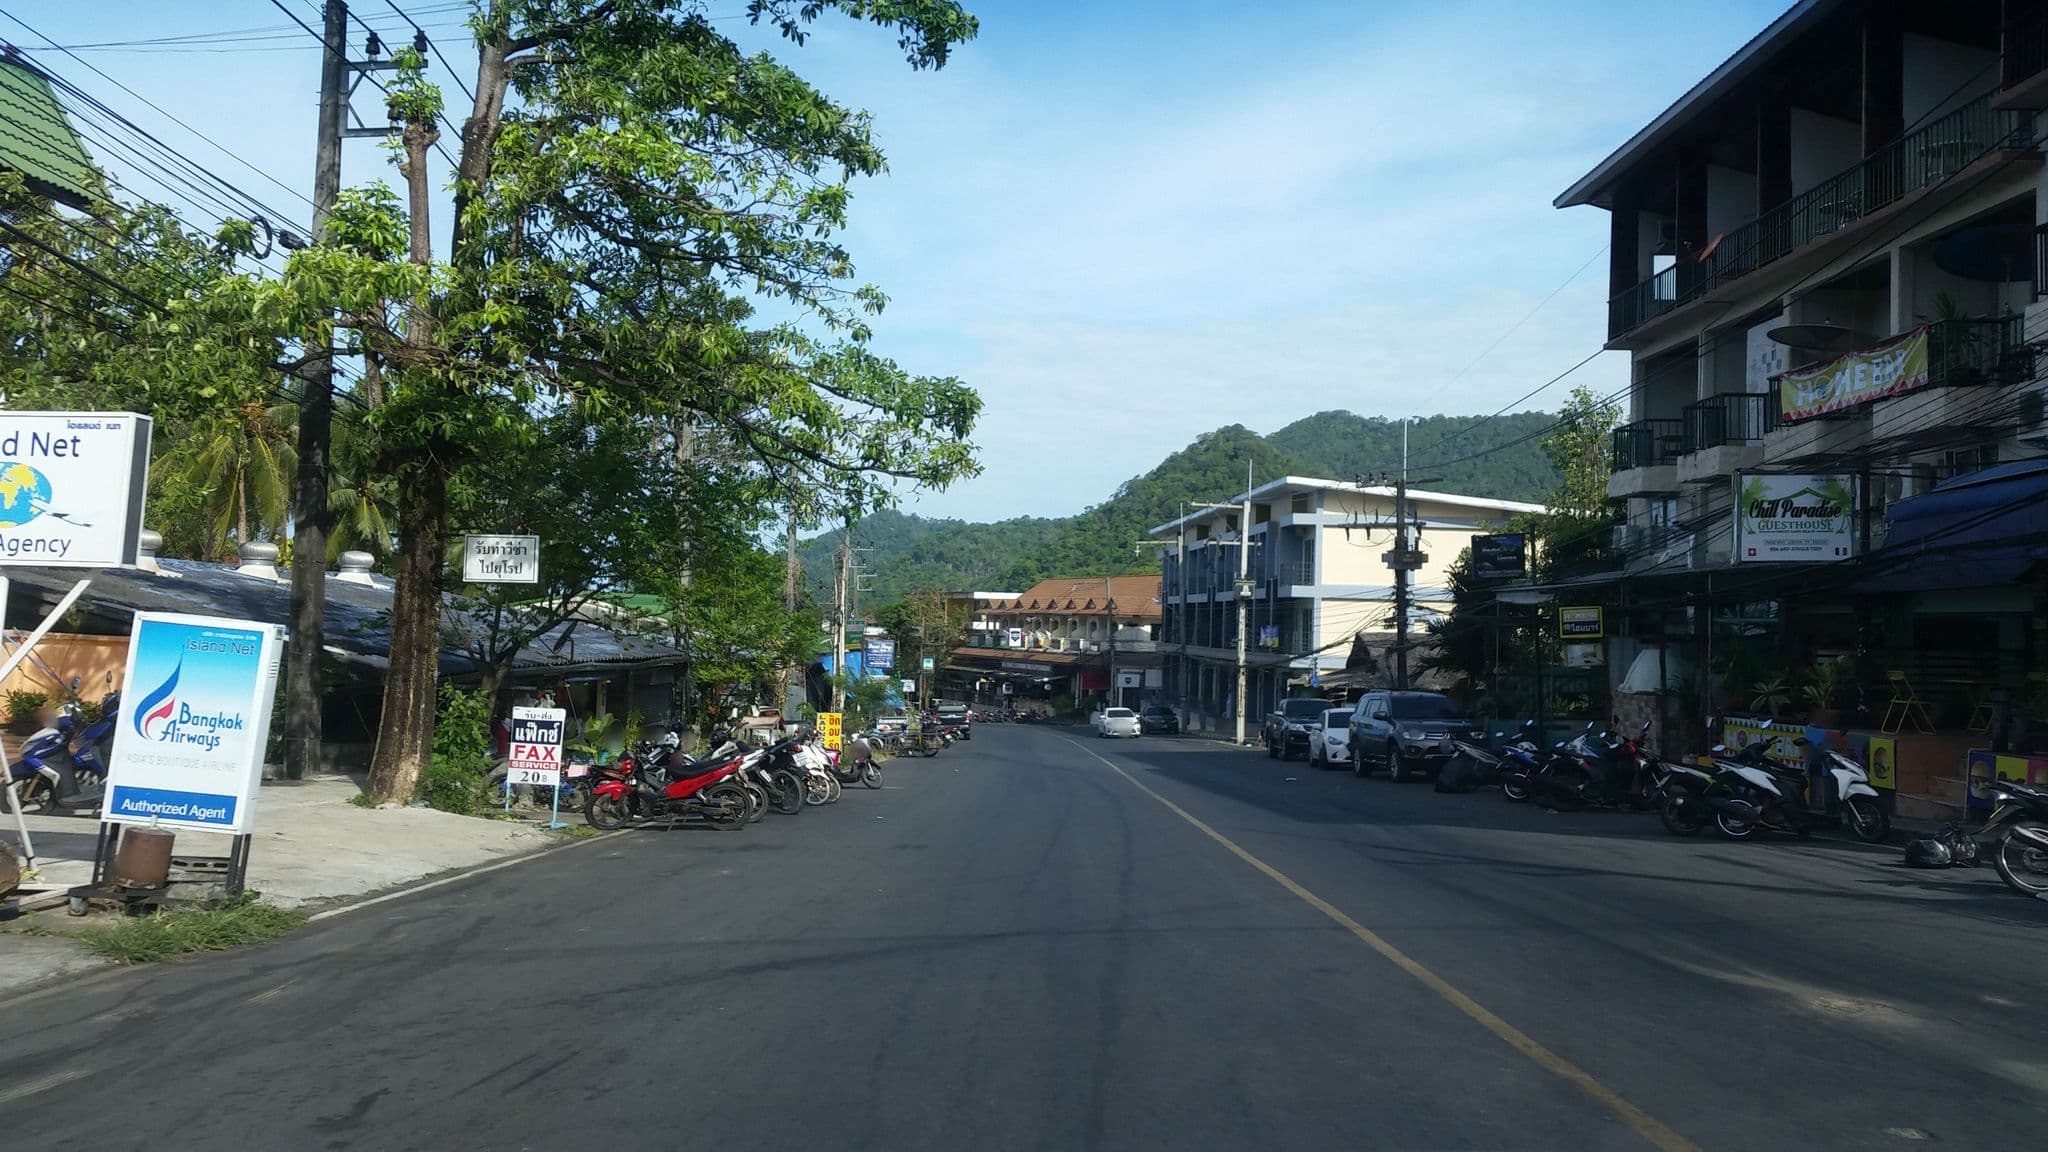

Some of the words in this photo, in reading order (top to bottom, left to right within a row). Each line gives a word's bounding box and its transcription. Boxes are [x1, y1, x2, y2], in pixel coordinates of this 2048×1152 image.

[30, 431, 81, 458] Net
[1749, 498, 1781, 519] Chill
[1781, 497, 1842, 519] Paradise
[1757, 519, 1835, 531] GUESTHOUSE
[475, 540, 528, 556] รับทำวีซ่า
[478, 558, 523, 579] ไปยุโรป
[186, 638, 227, 653] Island
[230, 640, 255, 656] Net
[178, 701, 244, 733] Bangkok
[159, 718, 221, 752] Airways
[828, 728, 840, 737] อบ
[514, 744, 556, 761] FAX
[511, 760, 558, 770] SERVICE
[520, 771, 540, 783] 20
[121, 797, 187, 816] Authorized
[189, 804, 226, 820] Agent
